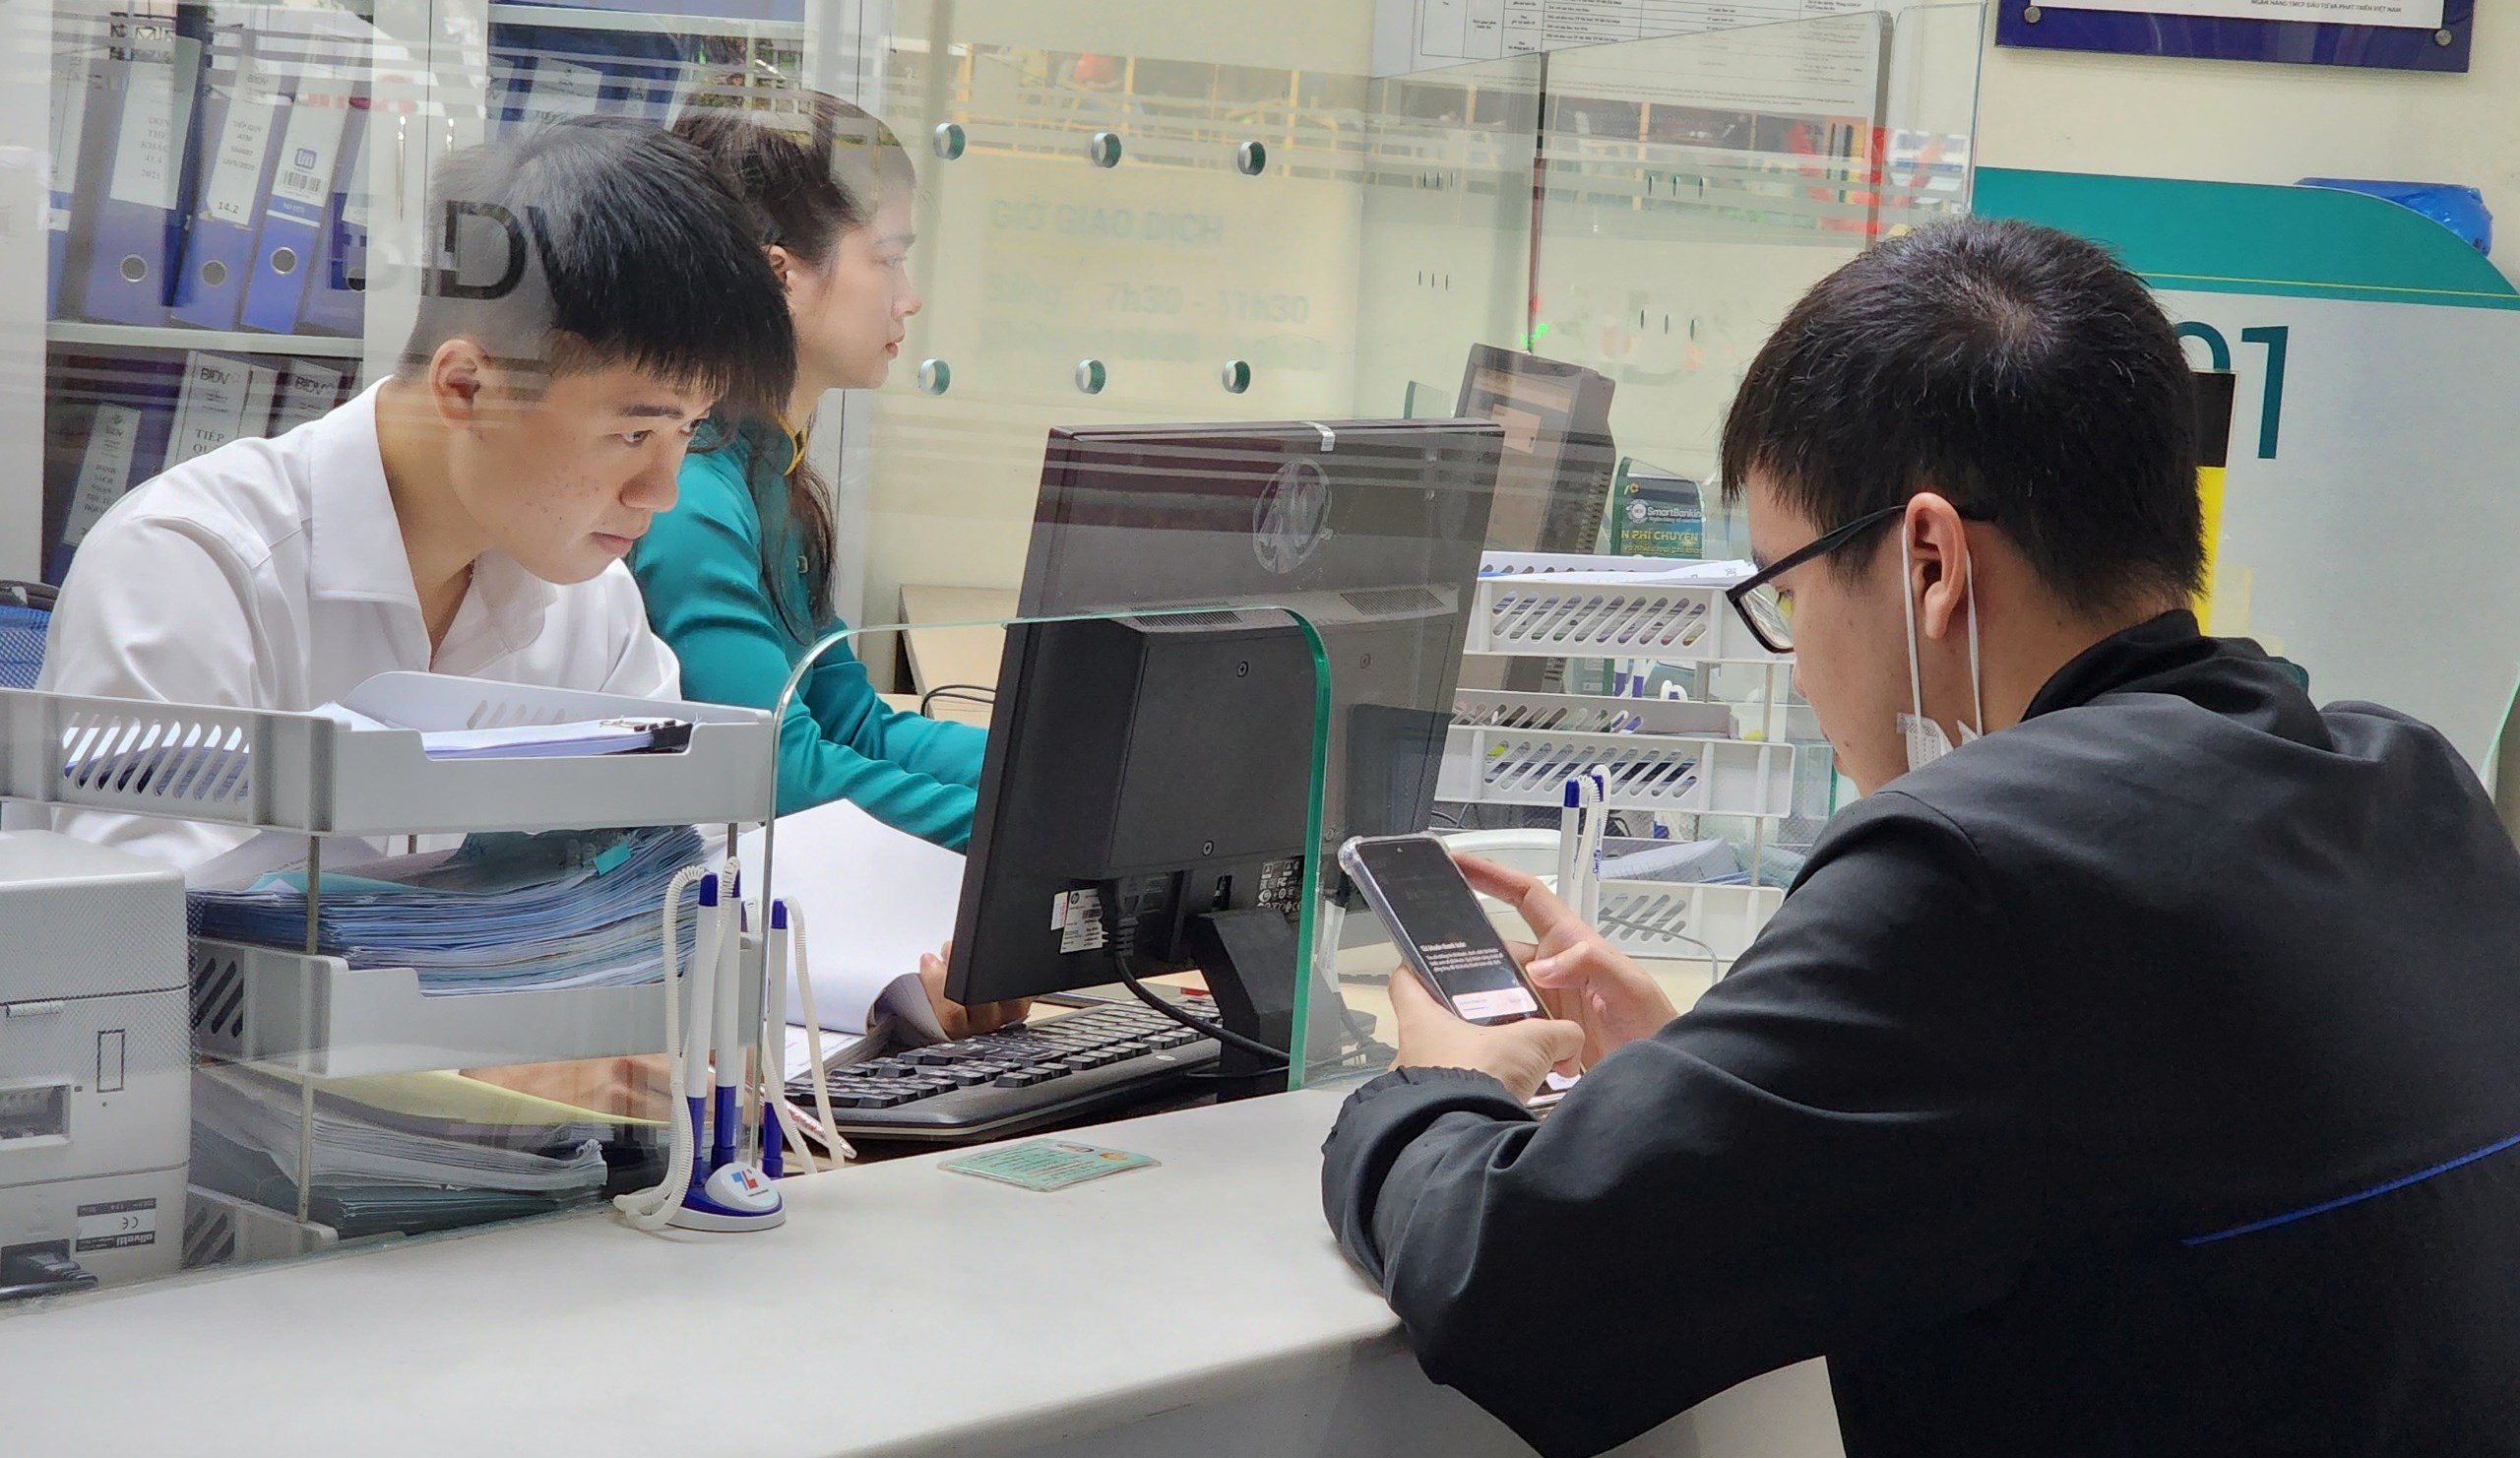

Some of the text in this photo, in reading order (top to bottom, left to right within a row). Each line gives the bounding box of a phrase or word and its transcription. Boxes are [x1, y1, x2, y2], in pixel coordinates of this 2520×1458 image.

[219, 200, 239, 215] 14.2
[1055, 202, 1134, 239] GIAO
[1142, 210, 1224, 249] DỊCH
[200, 367, 230, 385] BIDV
[295, 375, 326, 395] BIDV
[196, 427, 225, 443] TIẾP
[1647, 506, 1702, 518] SmartBankin
[116, 1233, 154, 1246] olivetti
